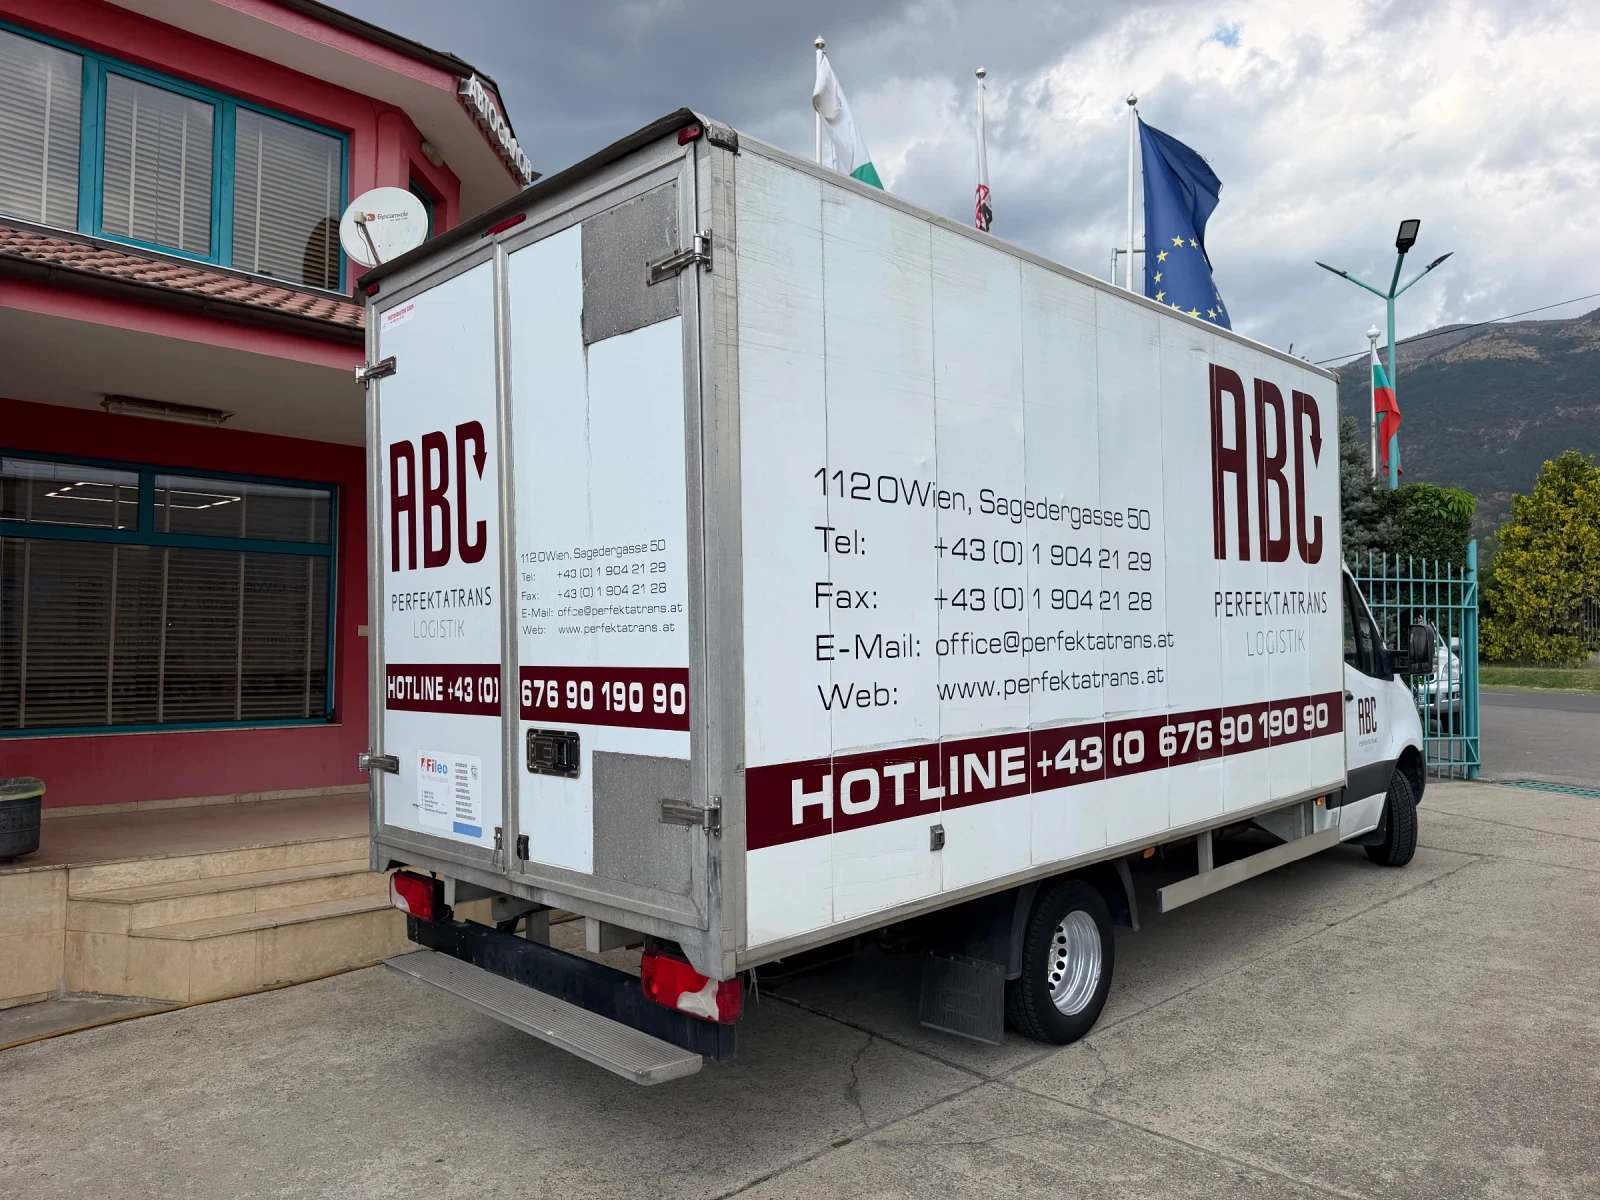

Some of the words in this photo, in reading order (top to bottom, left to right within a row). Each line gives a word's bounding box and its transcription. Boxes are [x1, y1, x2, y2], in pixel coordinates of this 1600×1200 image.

[1209, 363, 1323, 564] ABC
[390, 421, 487, 572] ABC
[979, 489, 1124, 530] Sagedergasse
[1127, 507, 1151, 531] 50
[573, 543, 648, 560] Sagedergasse
[649, 539, 666, 552] 50
[814, 526, 866, 555] Tel:
[934, 537, 986, 562] +43
[993, 540, 1023, 565] (0)
[1032, 543, 1040, 565] 1
[1050, 545, 1093, 568] 904
[1098, 549, 1120, 569] 21
[1127, 551, 1152, 571] 29
[521, 573, 536, 582] Tel:
[557, 569, 577, 579] +43
[579, 567, 593, 579] (0)
[596, 567, 601, 577] 1
[605, 564, 629, 576] 904
[631, 563, 645, 574] 21
[650, 561, 667, 574] 29
[391, 586, 492, 612] PERFEKTATRANS
[521, 591, 540, 601] Fax:
[557, 589, 577, 599] +43
[579, 587, 594, 598] (0)
[596, 586, 602, 597] 1
[605, 585, 629, 596] 904
[631, 584, 646, 595] 21
[650, 582, 667, 594] 28
[814, 582, 877, 610] Fax:
[934, 588, 986, 611] +43
[993, 587, 1024, 611] (0)
[1032, 588, 1041, 610] 1
[1051, 589, 1094, 611] 904
[1099, 590, 1121, 611] 21
[1128, 591, 1152, 611] 28
[1214, 591, 1328, 618] PERFEKTATRANS
[521, 607, 554, 619] E-Mail:
[413, 619, 465, 638] LOGISTIK
[522, 625, 546, 635] Web:
[558, 621, 676, 636] www.perfektatrans.at
[1246, 628, 1306, 657] LOGISTIK
[815, 633, 921, 661] E-Mail:
[935, 630, 1174, 658] office@perfektatrans.at
[387, 675, 444, 701] HOTLINE
[447, 676, 473, 703] +43
[478, 676, 499, 704] (0)
[521, 680, 559, 709] 676
[566, 680, 594, 711] 90
[601, 681, 644, 713] 190
[653, 683, 686, 715] 90
[817, 681, 898, 711] Web:
[936, 665, 1165, 701] www.perfektatrans.at
[1358, 696, 1377, 736] ABC
[426, 758, 448, 775] Fileo
[790, 747, 1026, 826] HOTLINE
[1036, 735, 1103, 780] +43
[1112, 730, 1146, 767] (0
[1158, 714, 1213, 757] 676
[1219, 713, 1254, 747] 90
[1258, 707, 1298, 740] 190
[1303, 702, 1329, 732] 90
